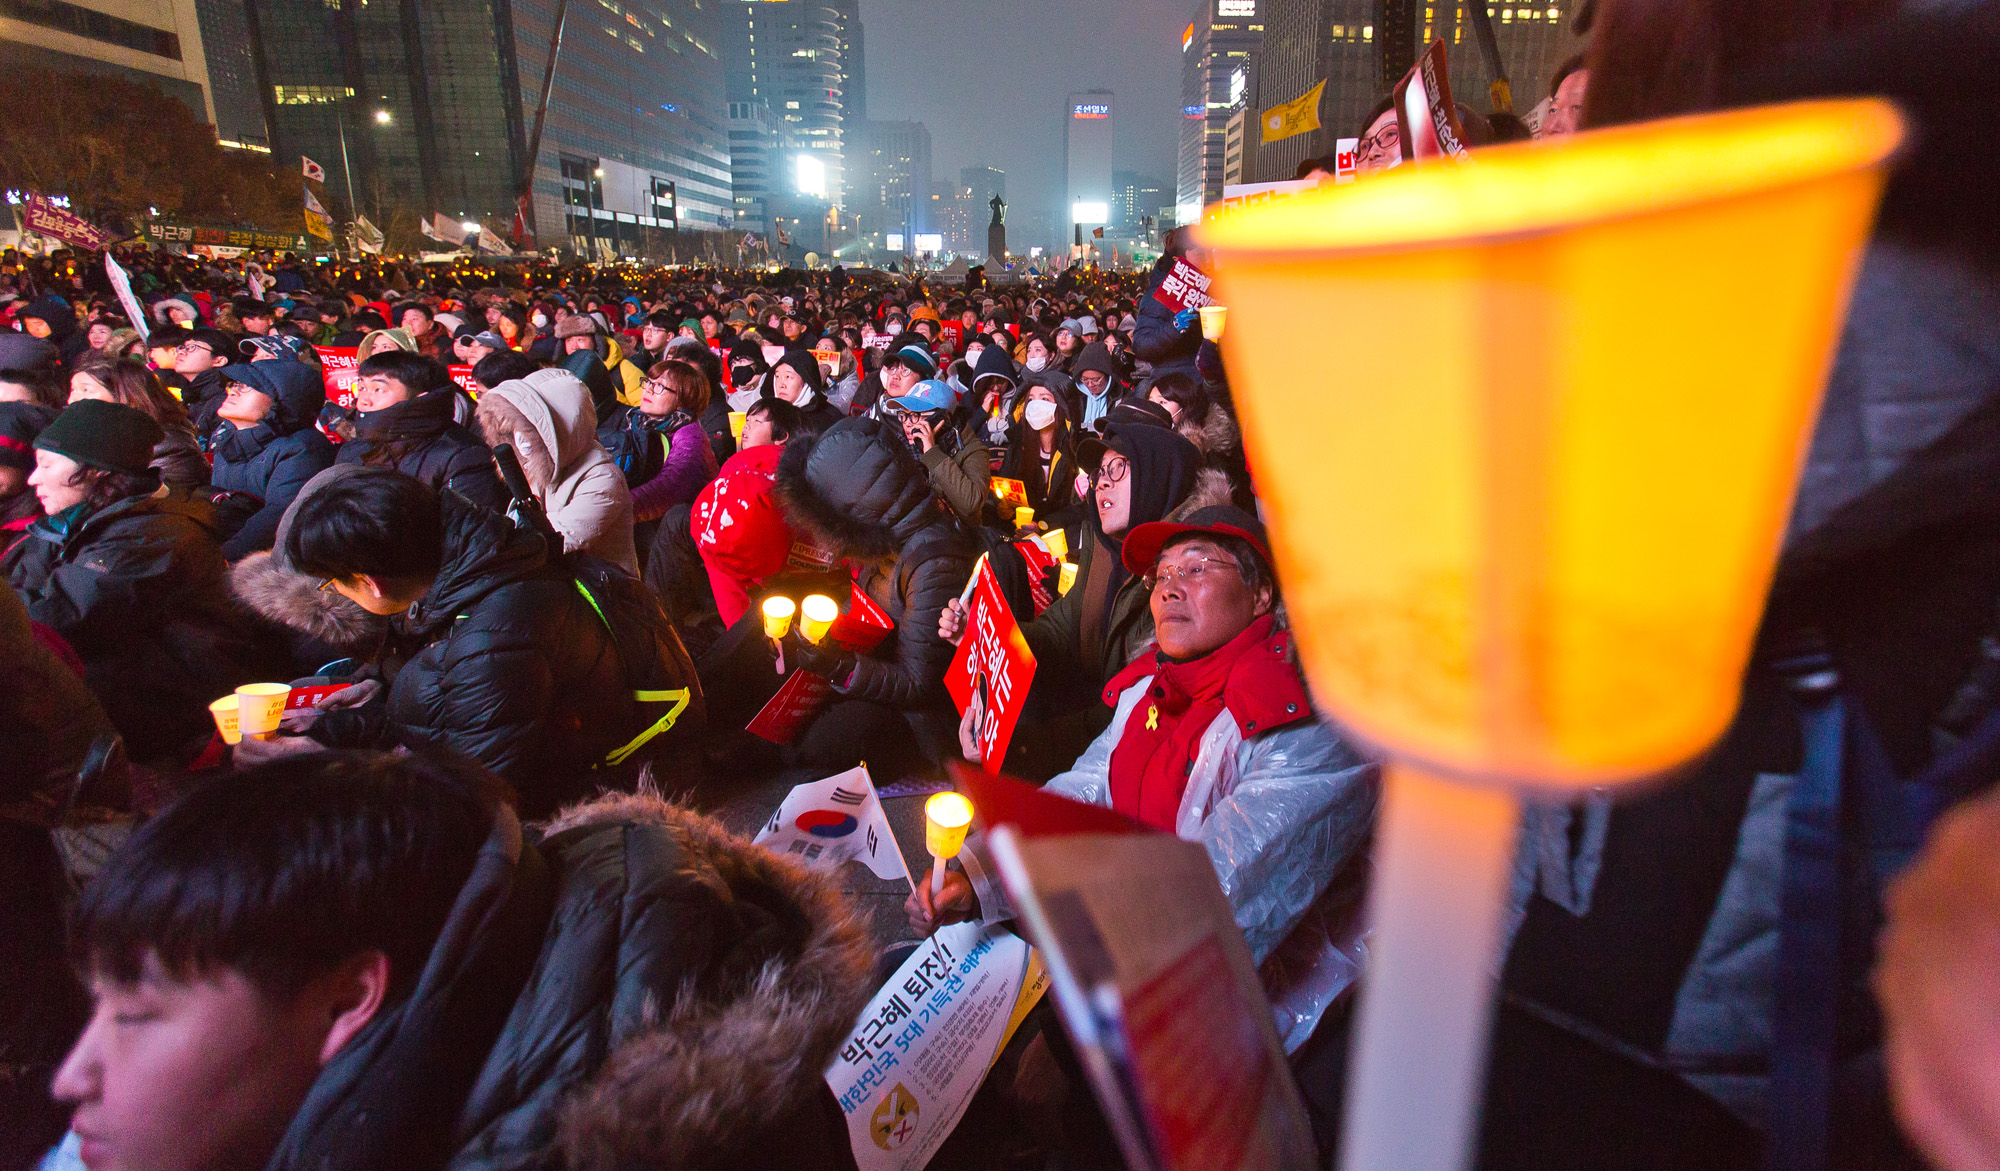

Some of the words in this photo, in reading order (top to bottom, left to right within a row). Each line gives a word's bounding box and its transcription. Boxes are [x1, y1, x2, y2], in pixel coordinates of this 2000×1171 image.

[1074, 104, 1109, 114] 조선일보
[150, 224, 192, 241] 박근혜
[228, 230, 253, 246] 국정
[255, 233, 293, 249] 정상화!
[1161, 273, 1188, 302] 즉각
[1173, 260, 1212, 293] 박근혜
[453, 375, 477, 391] 박근
[976, 595, 1013, 715] 박근혜는
[839, 993, 912, 1066] 박근혜
[903, 943, 957, 1002] 퇴진!
[894, 1020, 925, 1053] 5대
[919, 976, 965, 1024] 기득권
[959, 933, 995, 974] 해체!
